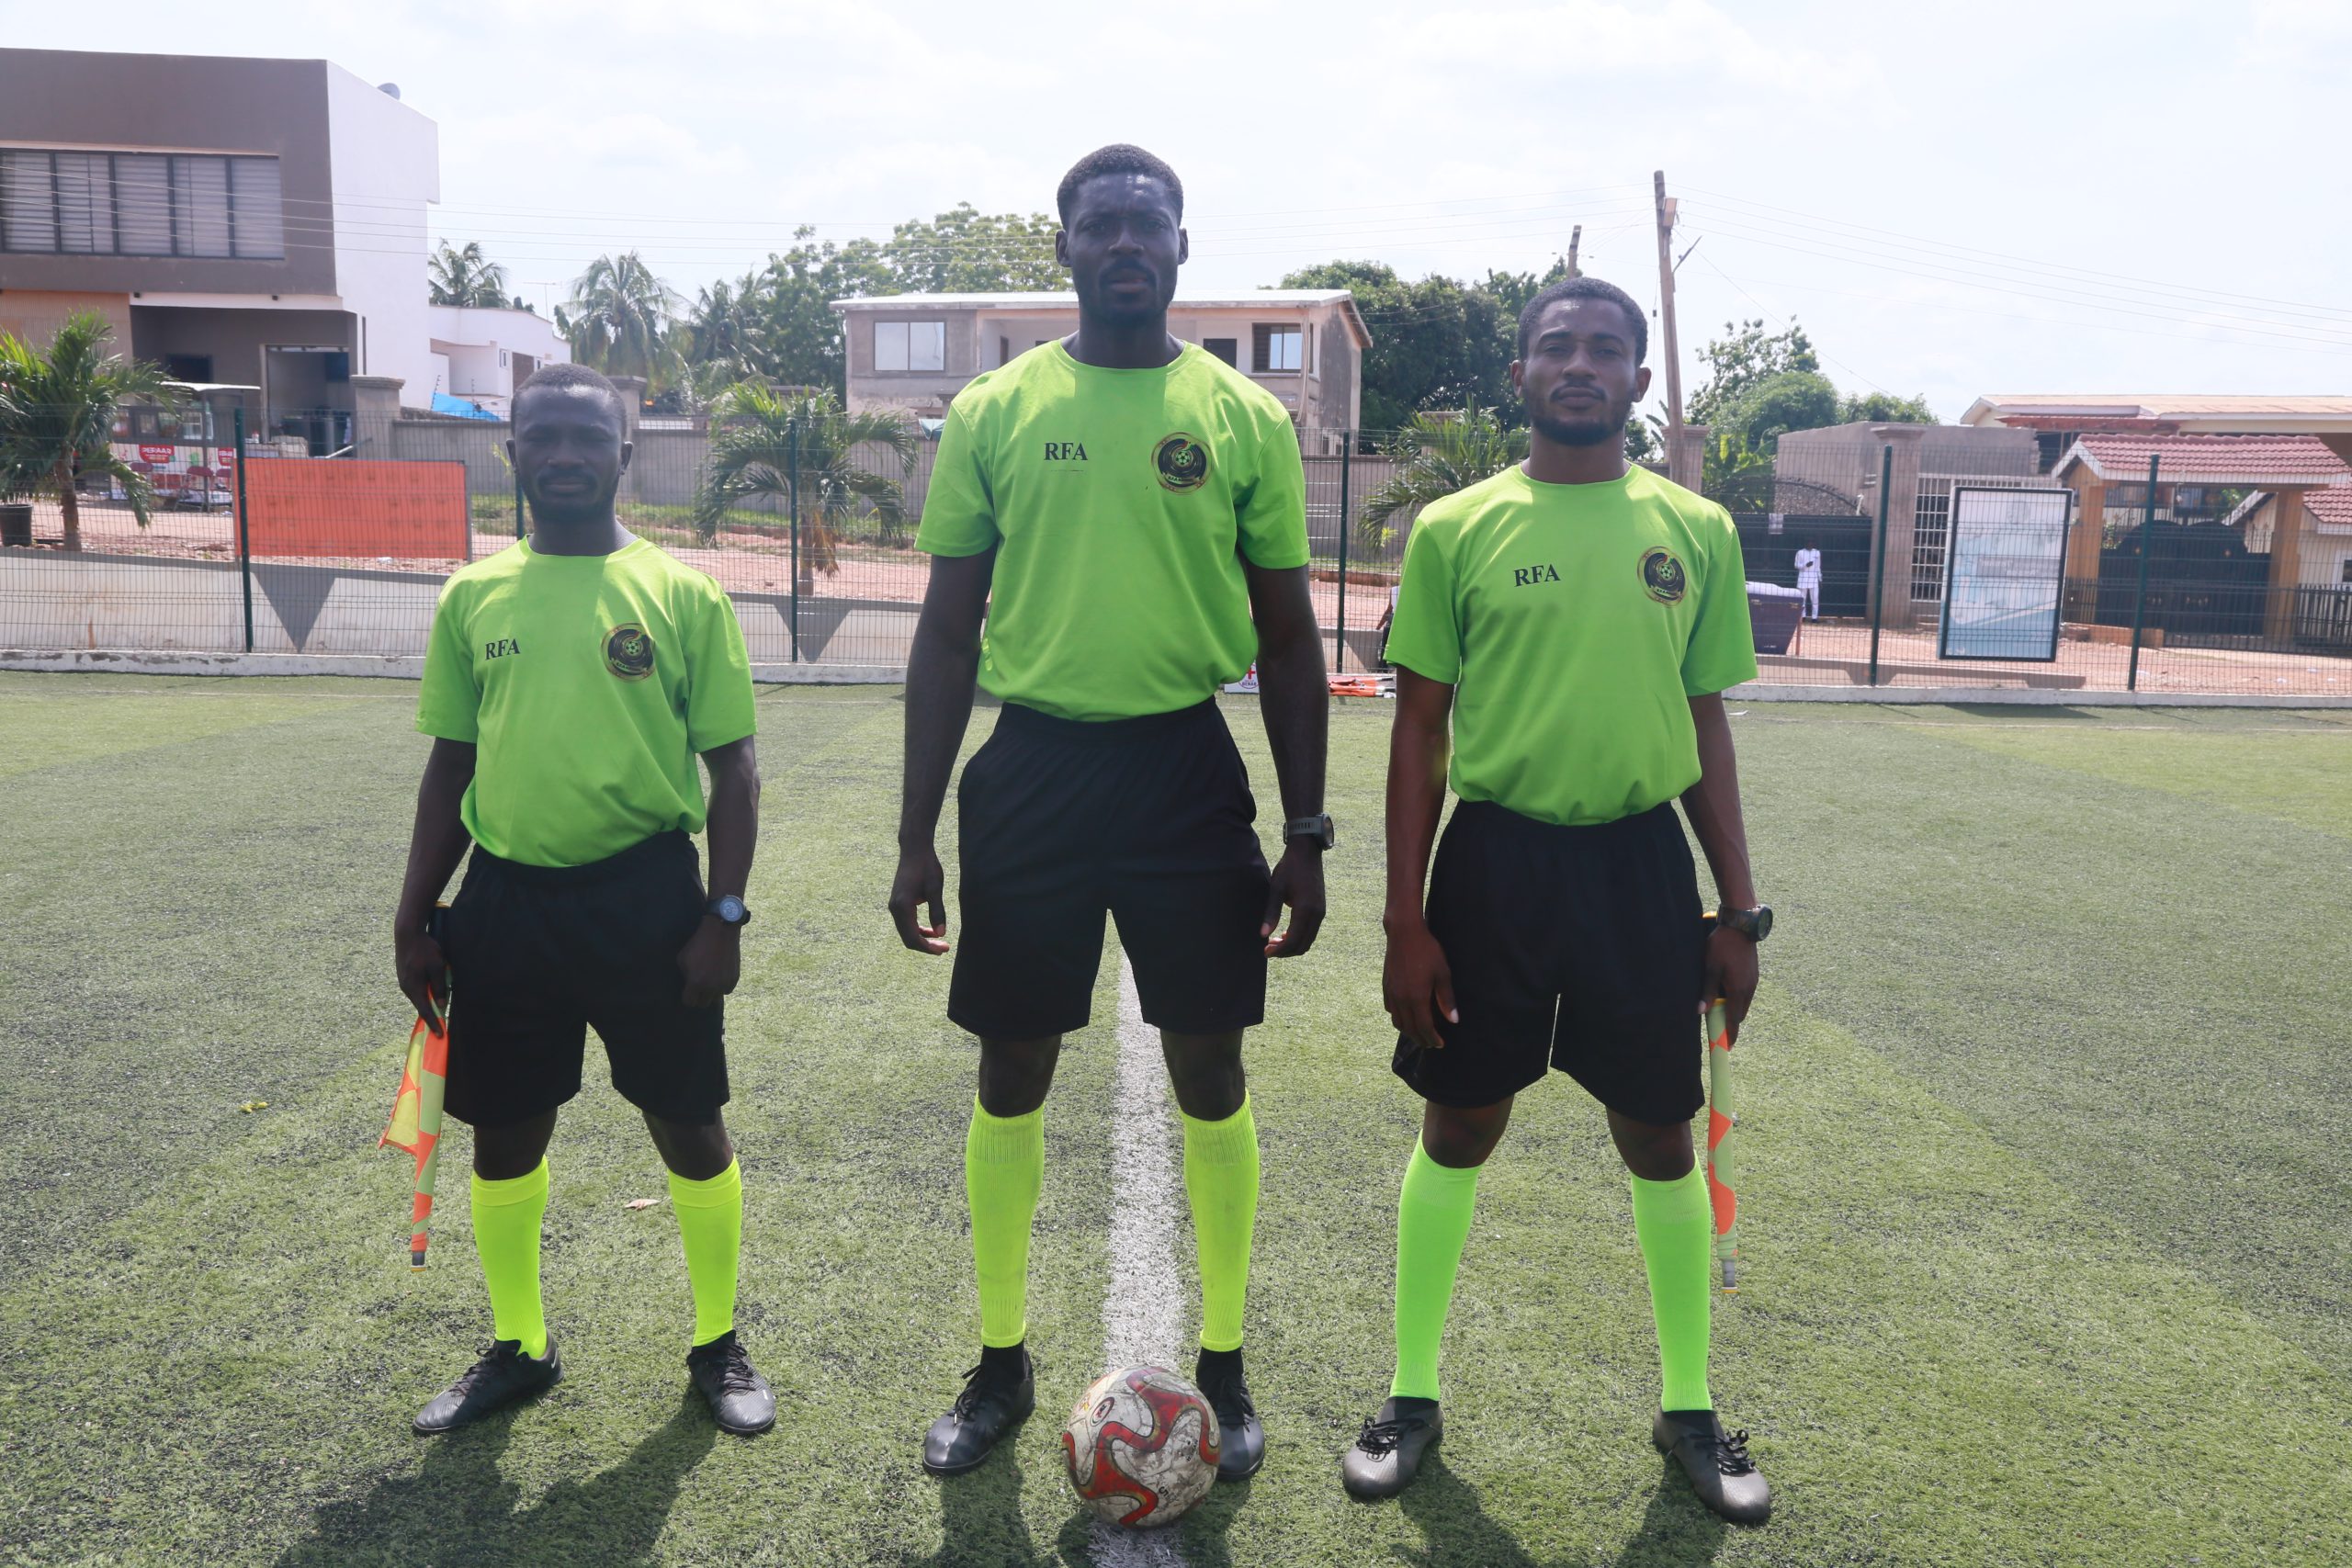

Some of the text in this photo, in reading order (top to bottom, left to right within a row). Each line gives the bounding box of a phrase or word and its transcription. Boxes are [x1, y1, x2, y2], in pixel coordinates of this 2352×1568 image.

[1044, 442, 1088, 461] RFA
[1513, 564, 1561, 587] RFA
[485, 638, 521, 660] RFA
